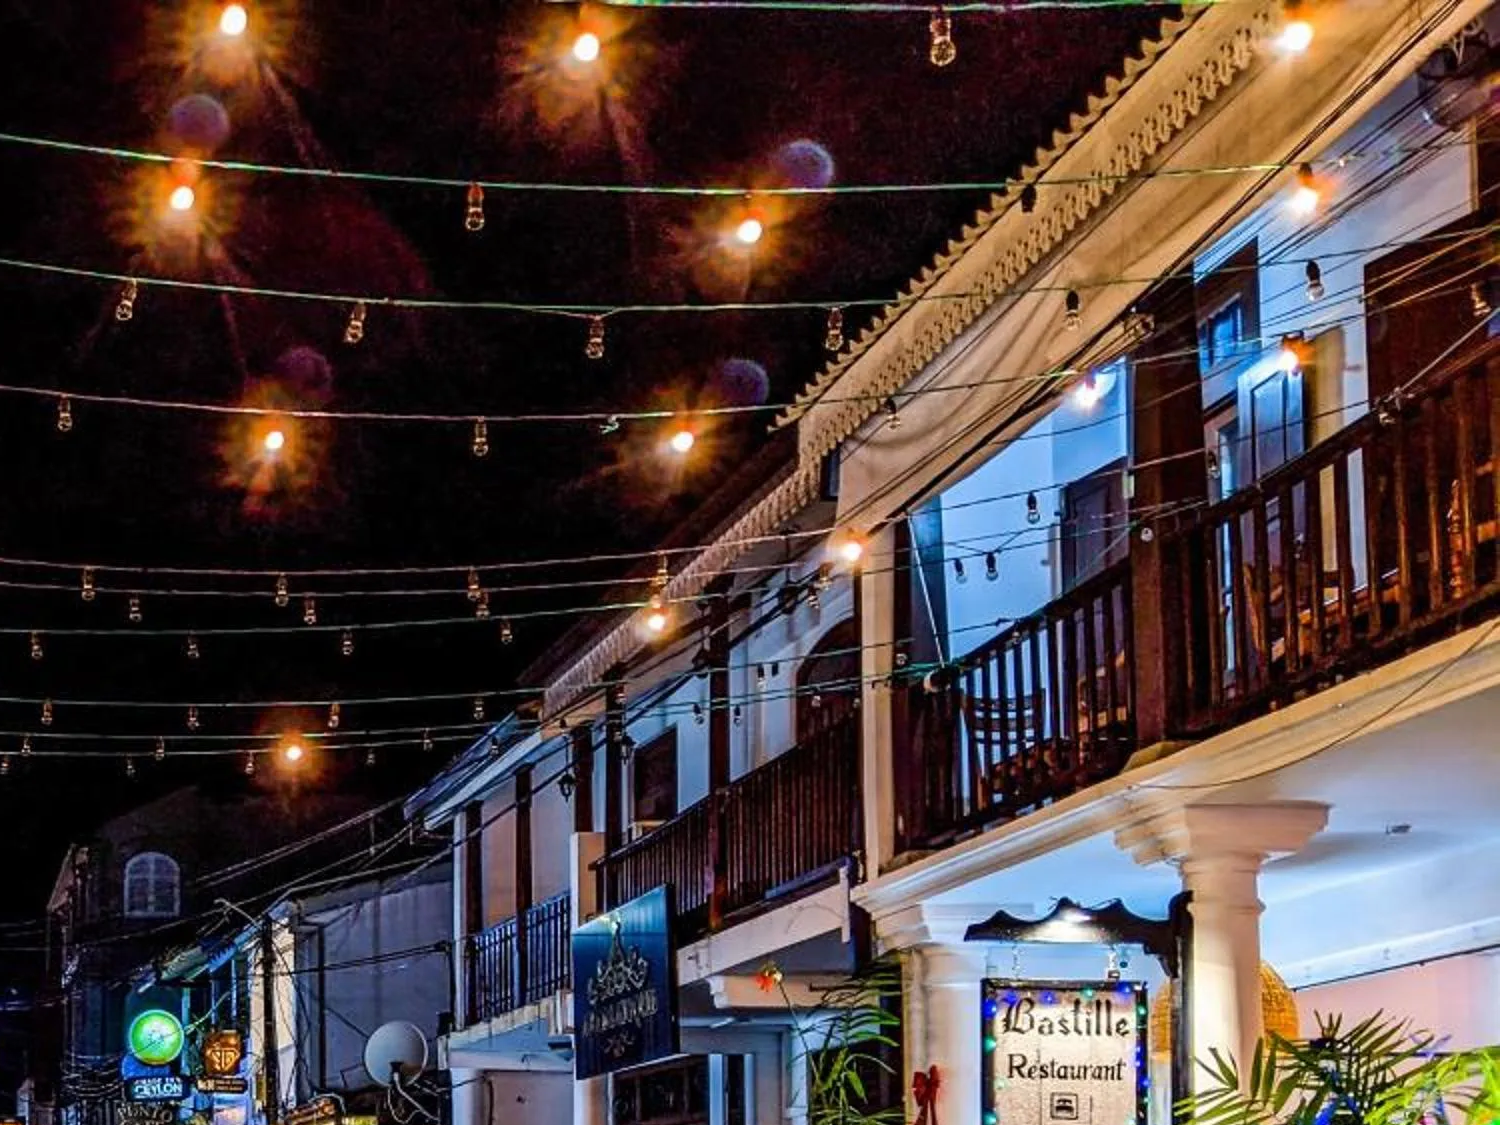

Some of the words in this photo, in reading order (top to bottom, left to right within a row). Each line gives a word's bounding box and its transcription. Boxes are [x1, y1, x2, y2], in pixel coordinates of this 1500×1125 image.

[1001, 997, 1131, 1037] Bastille
[1008, 1053, 1127, 1081] Restaurant
[133, 1083, 183, 1095] CEYLON
